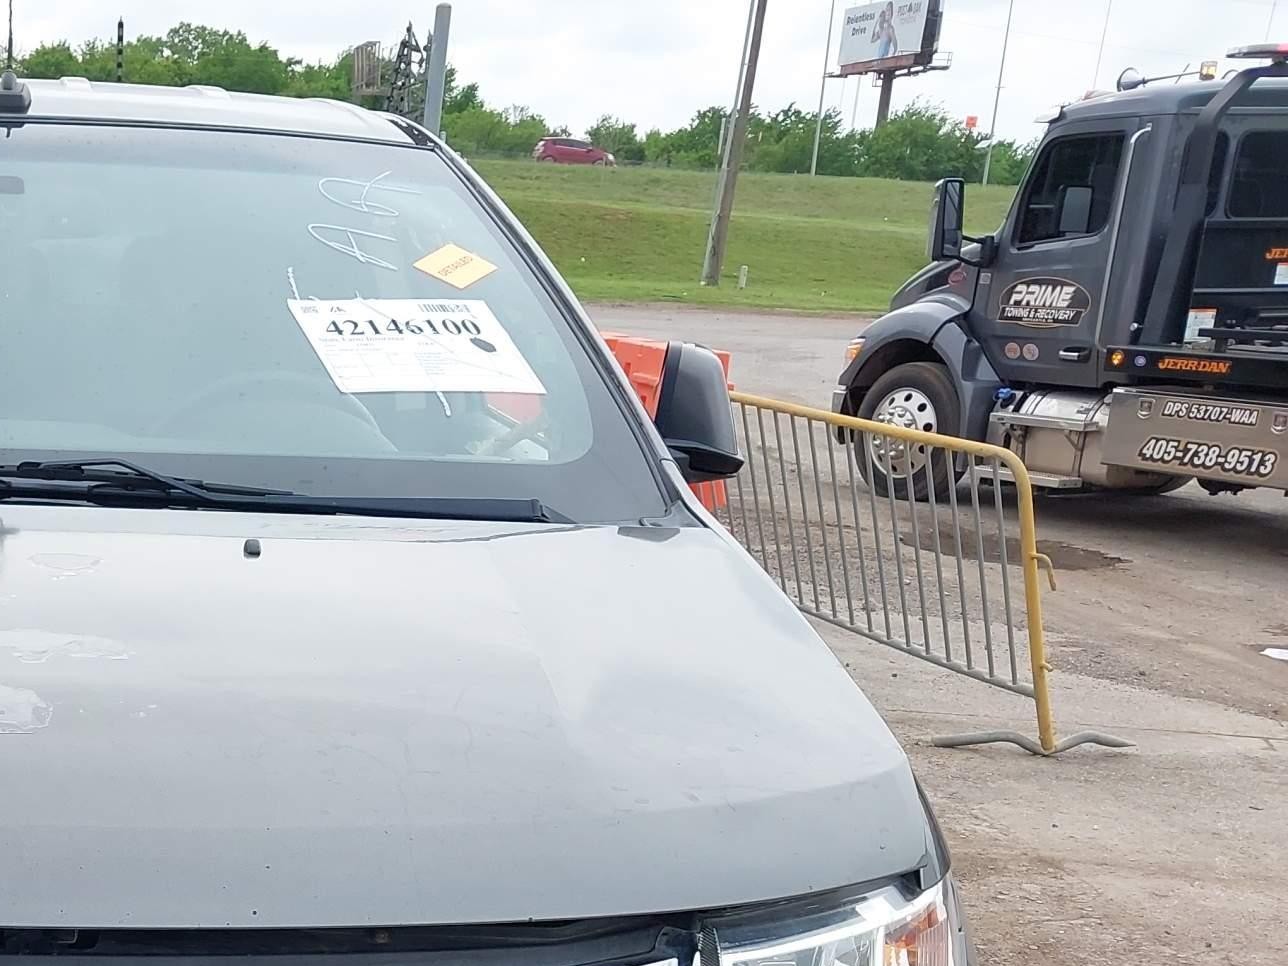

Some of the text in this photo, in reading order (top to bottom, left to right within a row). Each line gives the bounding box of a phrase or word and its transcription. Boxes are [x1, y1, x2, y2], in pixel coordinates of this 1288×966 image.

[846, 12, 876, 25] Relentless
[851, 26, 867, 36] Drive
[437, 255, 474, 277] DETAILED
[1009, 283, 1078, 308] PRIME
[1004, 307, 1030, 318] TOWING
[1029, 309, 1036, 318] &
[1035, 310, 1077, 321] RECOVERY
[325, 317, 482, 336] 42146100
[1163, 401, 1259, 425] DPS 53707-WAA
[1141, 438, 1277, 475] 405-738-9513
